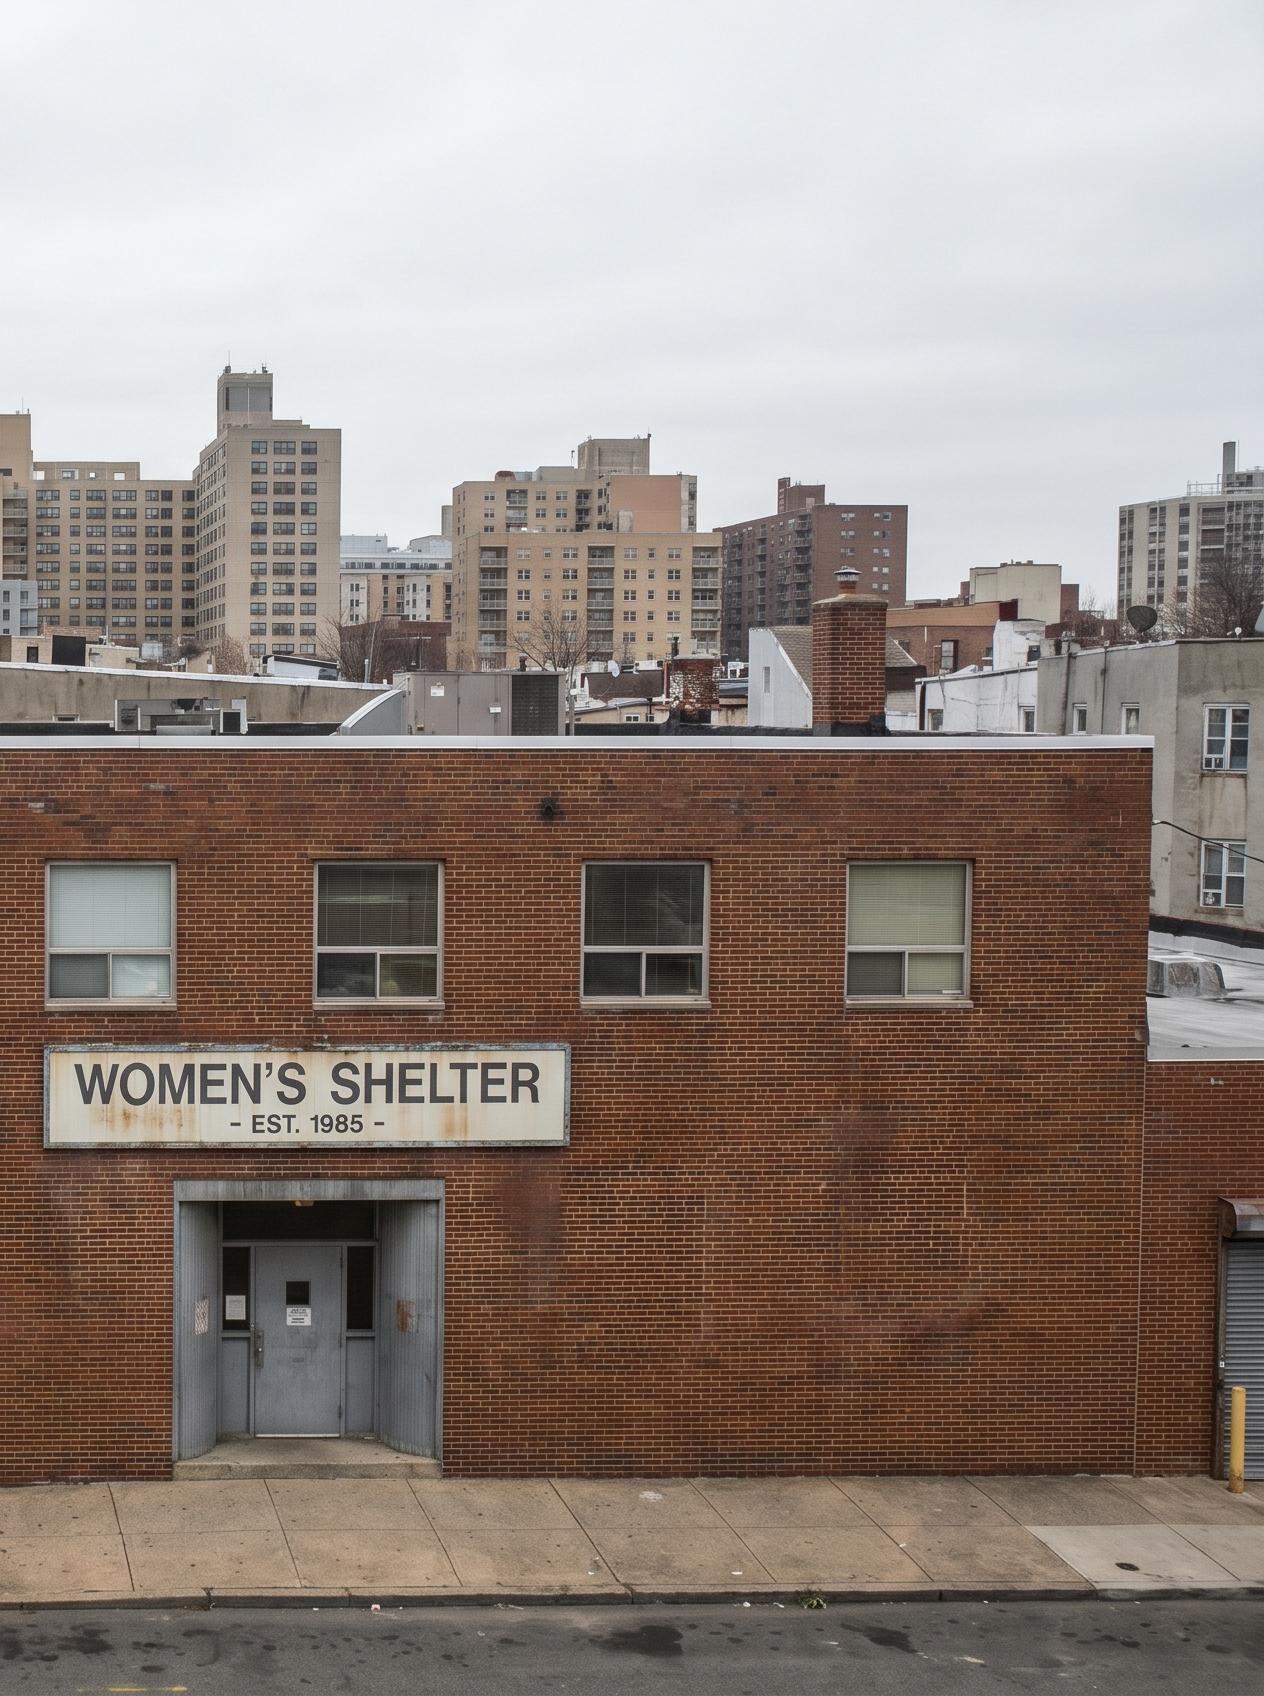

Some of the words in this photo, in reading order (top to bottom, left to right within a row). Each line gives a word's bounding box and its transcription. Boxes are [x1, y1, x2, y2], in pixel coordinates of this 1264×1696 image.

[74, 1061, 307, 1106] WOMEN'S
[330, 1061, 540, 1106] SHELTER
[252, 1114, 300, 1134] EST.
[310, 1113, 364, 1134] 1985
